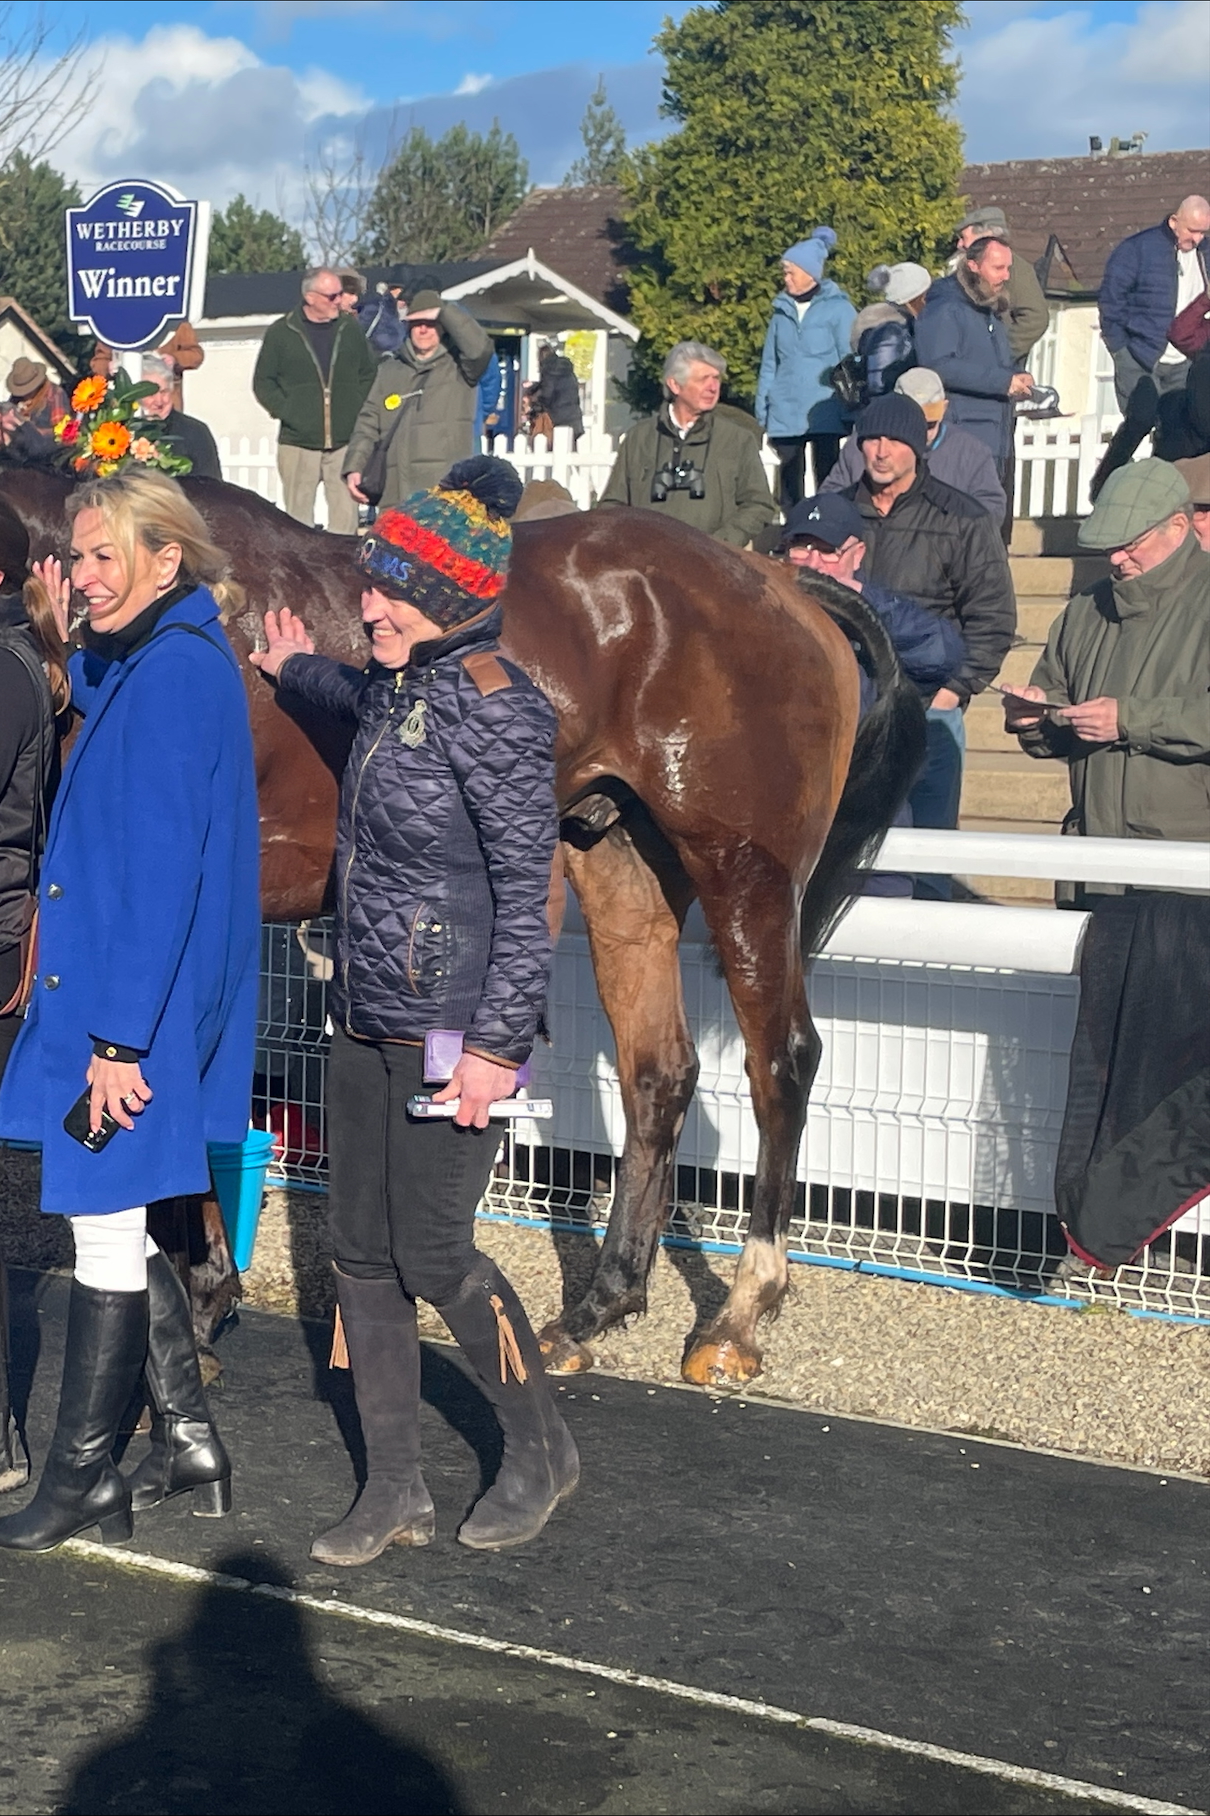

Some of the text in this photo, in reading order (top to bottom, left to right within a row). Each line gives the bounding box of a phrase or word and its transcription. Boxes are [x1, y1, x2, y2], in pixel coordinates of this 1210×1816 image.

[76, 219, 184, 240] WETHERBY
[95, 239, 167, 252] RACECOURSE
[77, 267, 181, 299] Winner
